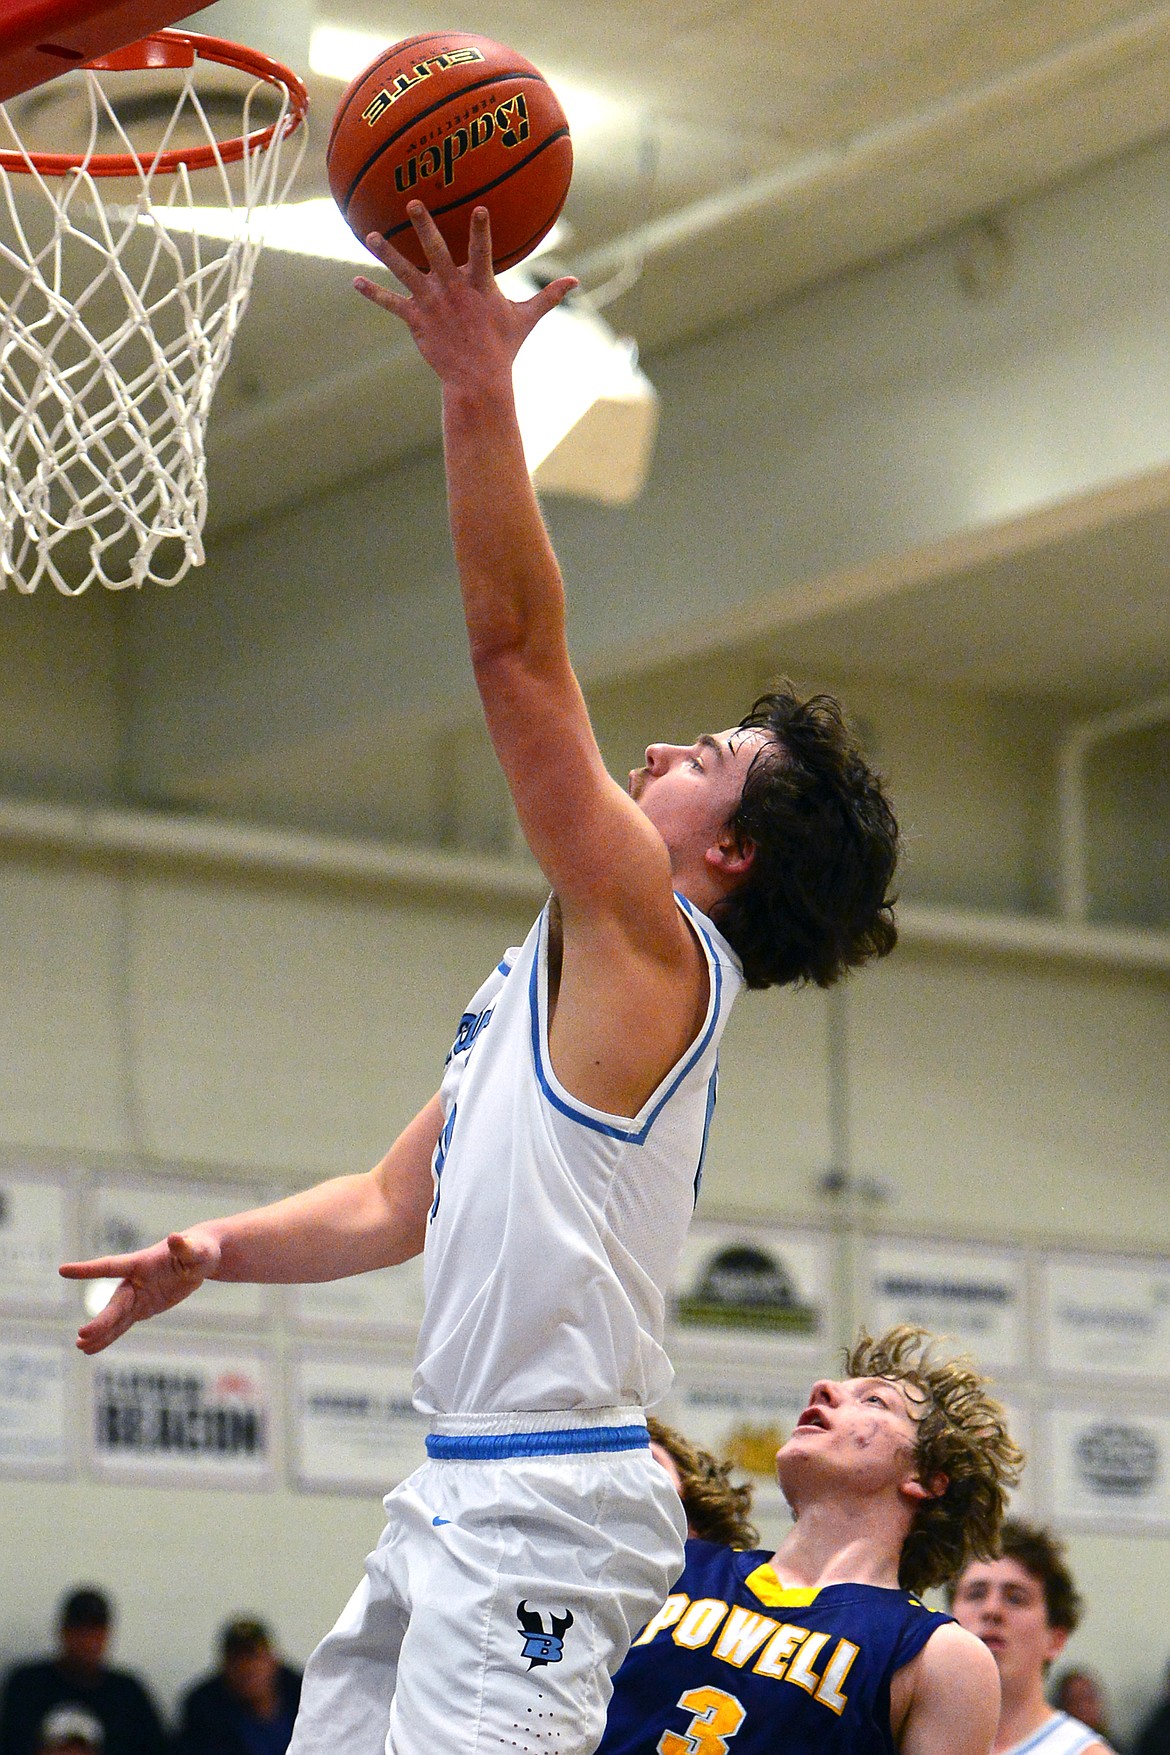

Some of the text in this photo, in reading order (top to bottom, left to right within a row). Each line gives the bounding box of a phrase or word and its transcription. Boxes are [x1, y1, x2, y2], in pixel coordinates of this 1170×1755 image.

[361, 47, 486, 127] ELITE
[407, 95, 496, 153] PERFECTION
[394, 92, 530, 192] Baden
[633, 1593, 860, 1717] POWELL
[657, 1685, 747, 1755] 3
